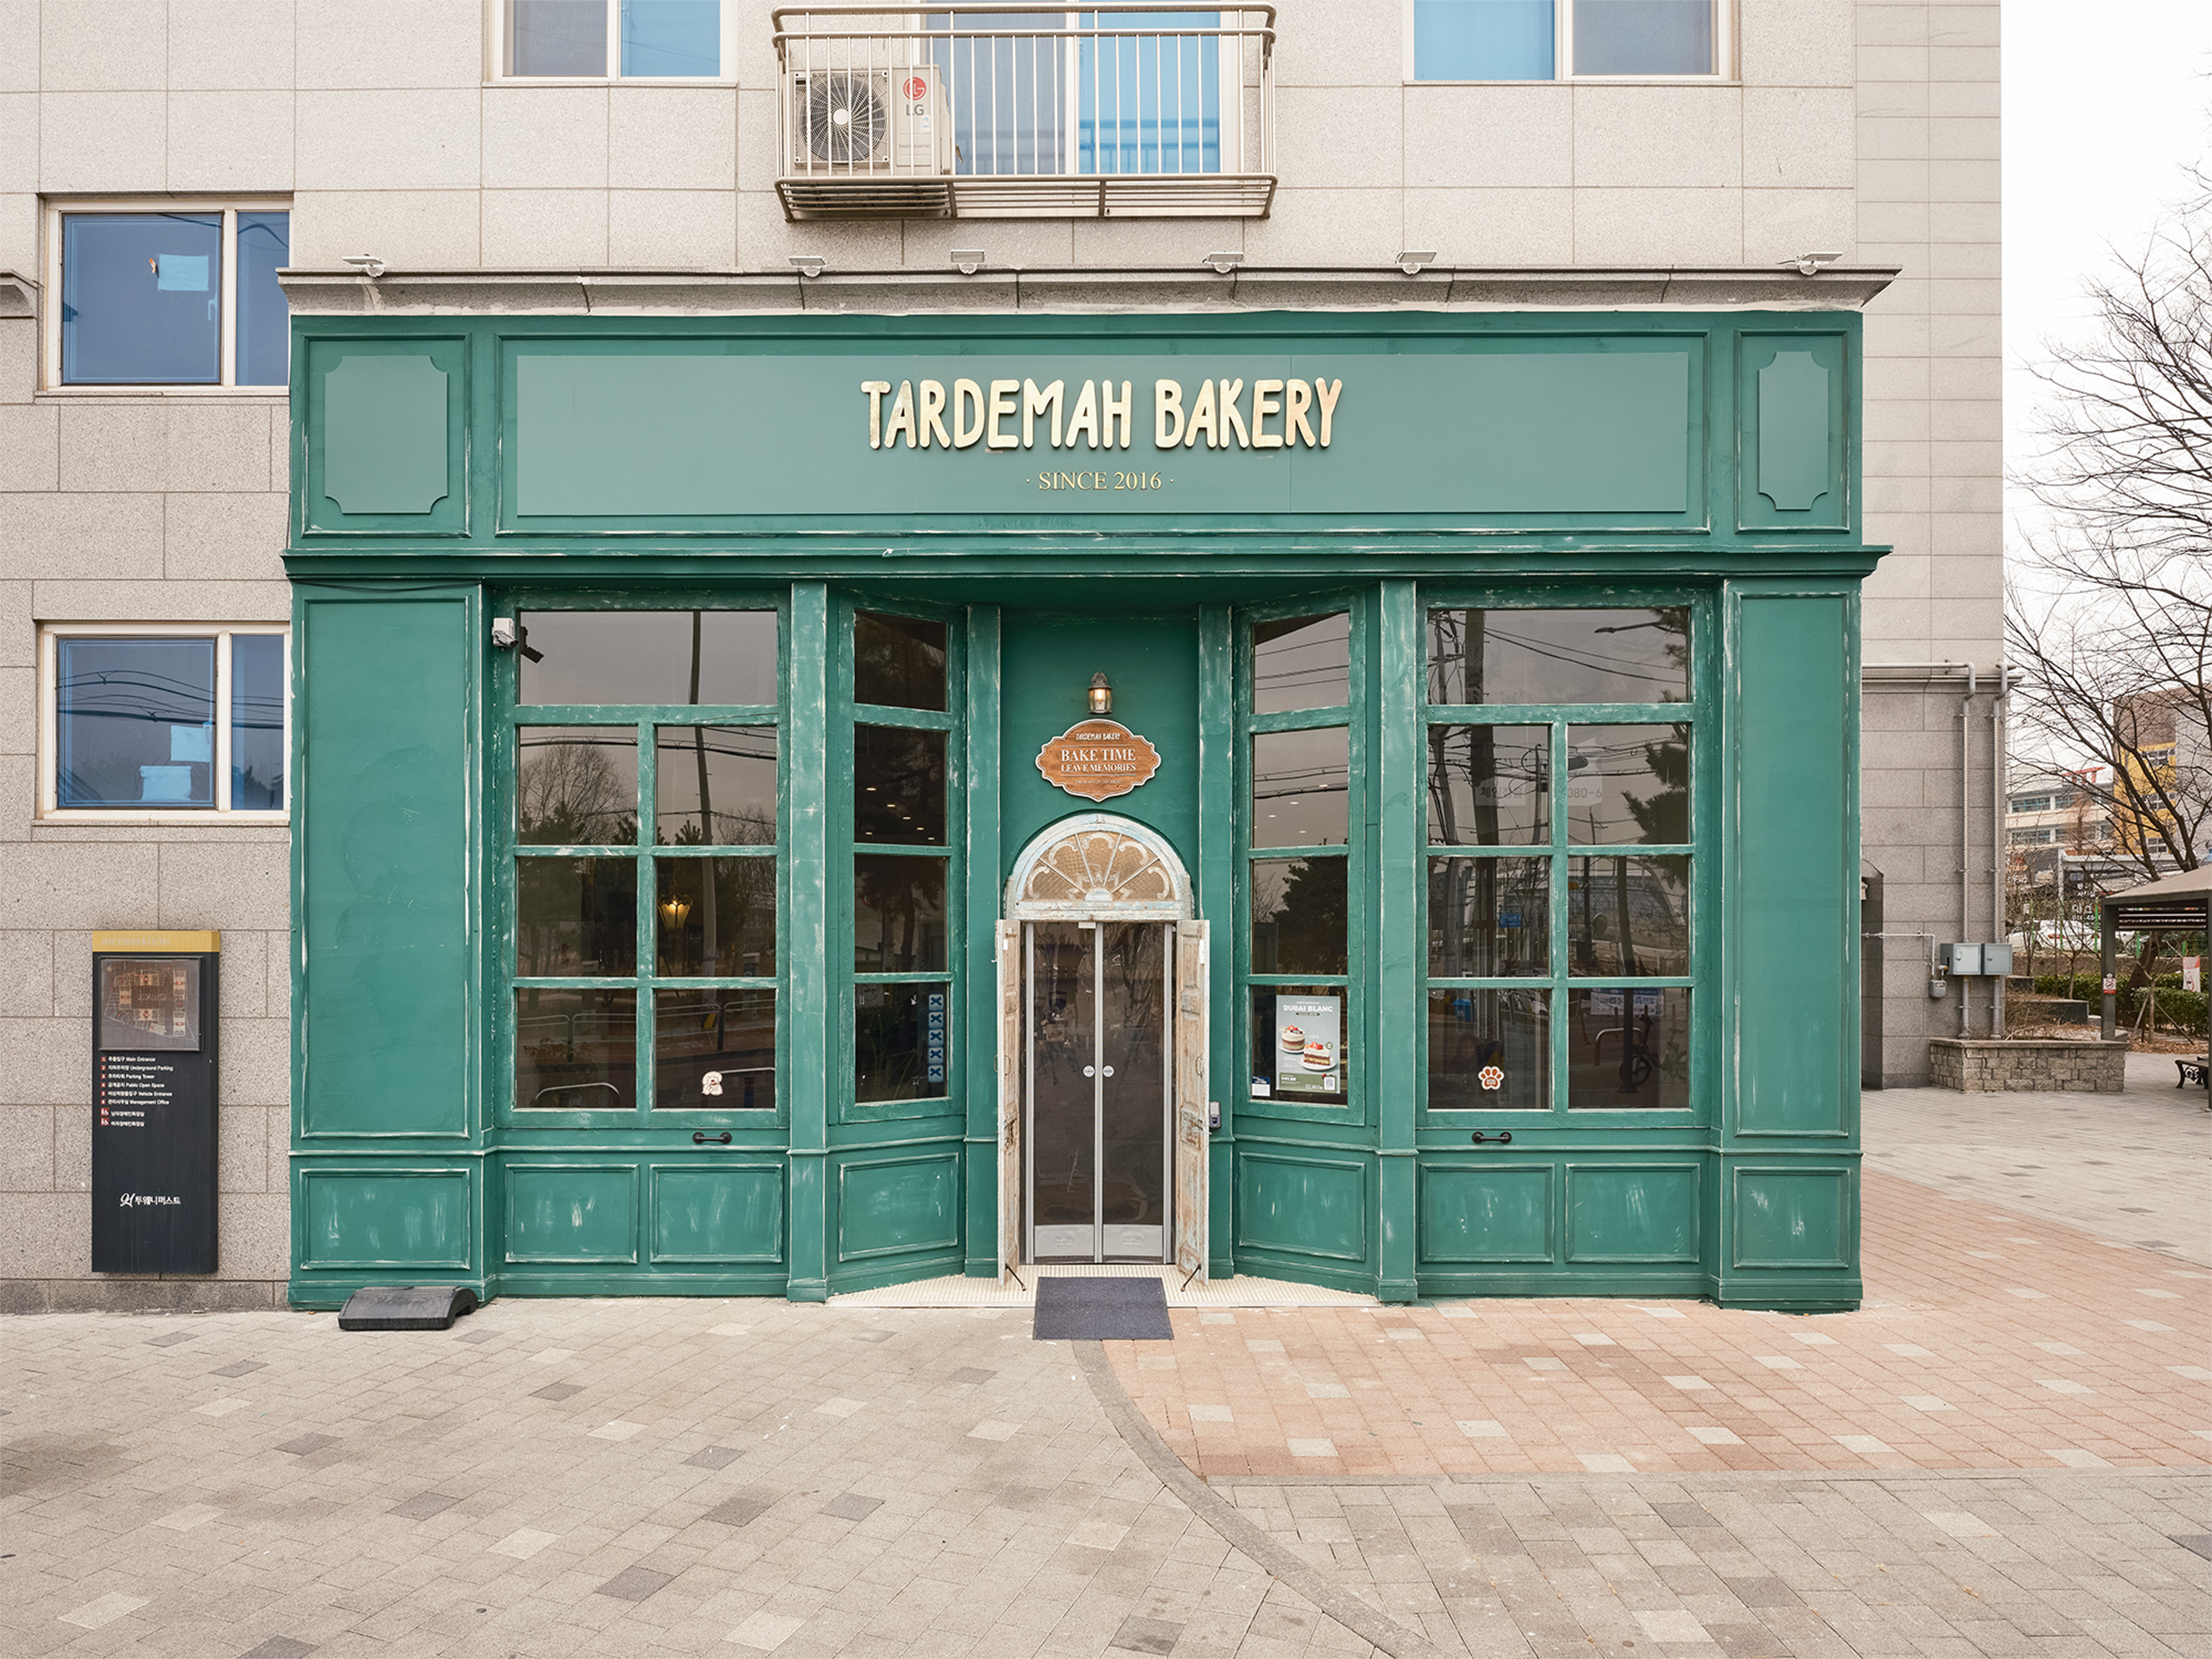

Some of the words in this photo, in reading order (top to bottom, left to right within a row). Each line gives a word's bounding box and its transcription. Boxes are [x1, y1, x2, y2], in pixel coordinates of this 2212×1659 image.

[906, 104, 924, 116] LG
[860, 378, 1132, 449] TARDEMAH
[1155, 377, 1343, 448] BAKERY
[1039, 472, 1107, 490] SINCE
[1114, 472, 1162, 490] 2016
[1061, 749, 1098, 762] BAKE
[1101, 749, 1136, 761] TIME
[1061, 764, 1088, 772] LEAVE
[1090, 764, 1136, 772] MEMORIES
[101, 937, 170, 946] INFORMATION
